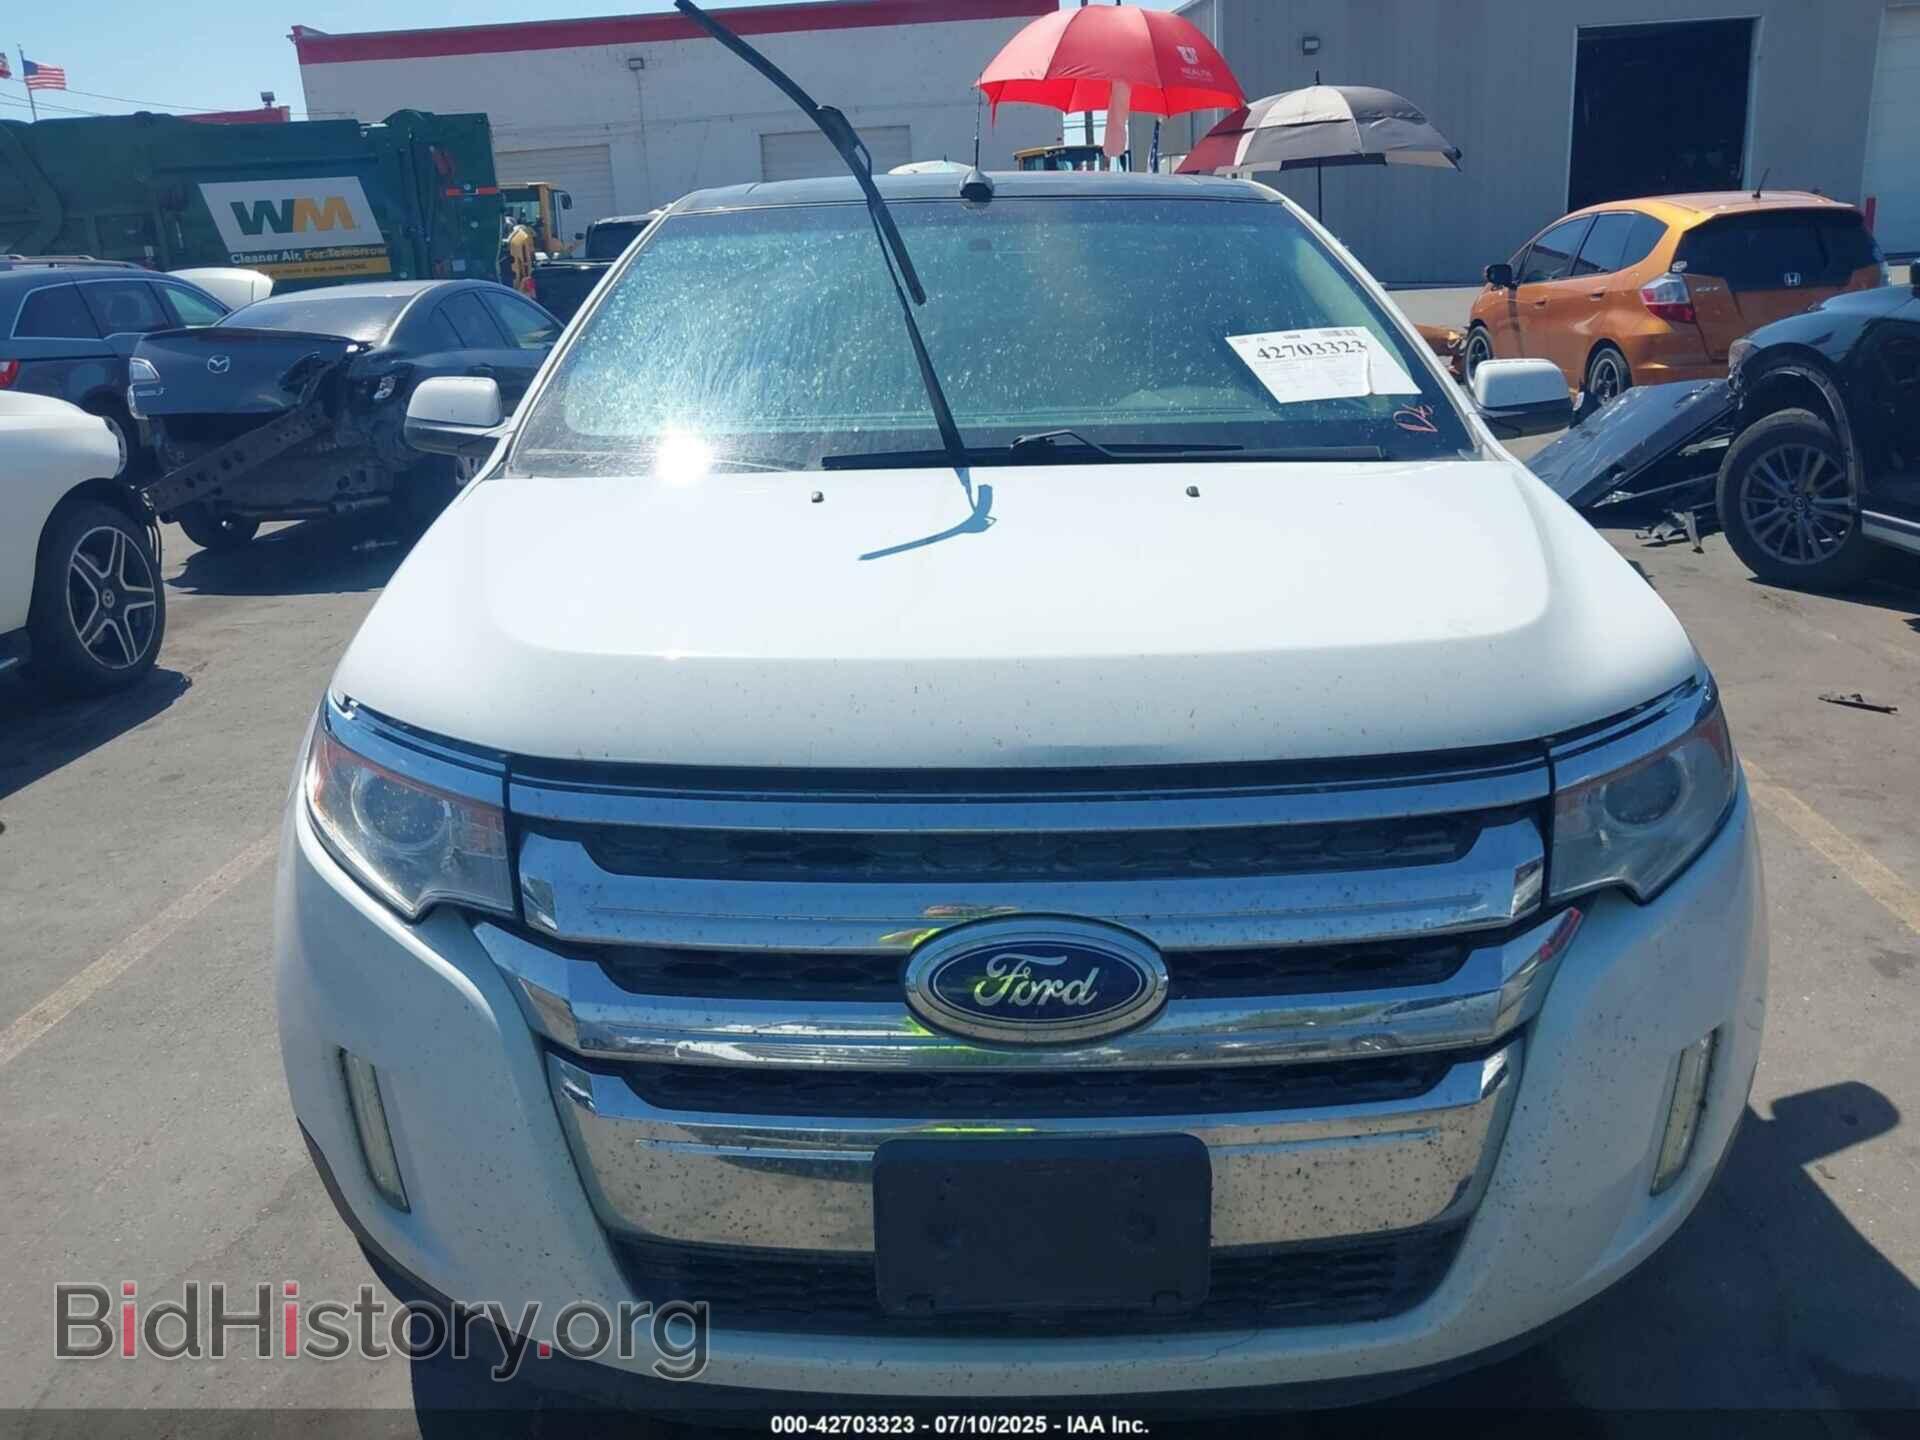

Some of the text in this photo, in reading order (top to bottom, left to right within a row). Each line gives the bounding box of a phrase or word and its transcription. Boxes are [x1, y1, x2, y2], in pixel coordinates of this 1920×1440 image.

[230, 196, 353, 235] WM
[231, 252, 279, 264] Cleaner
[1257, 340, 1367, 359] 42703323
[974, 952, 1099, 1006] Ford
